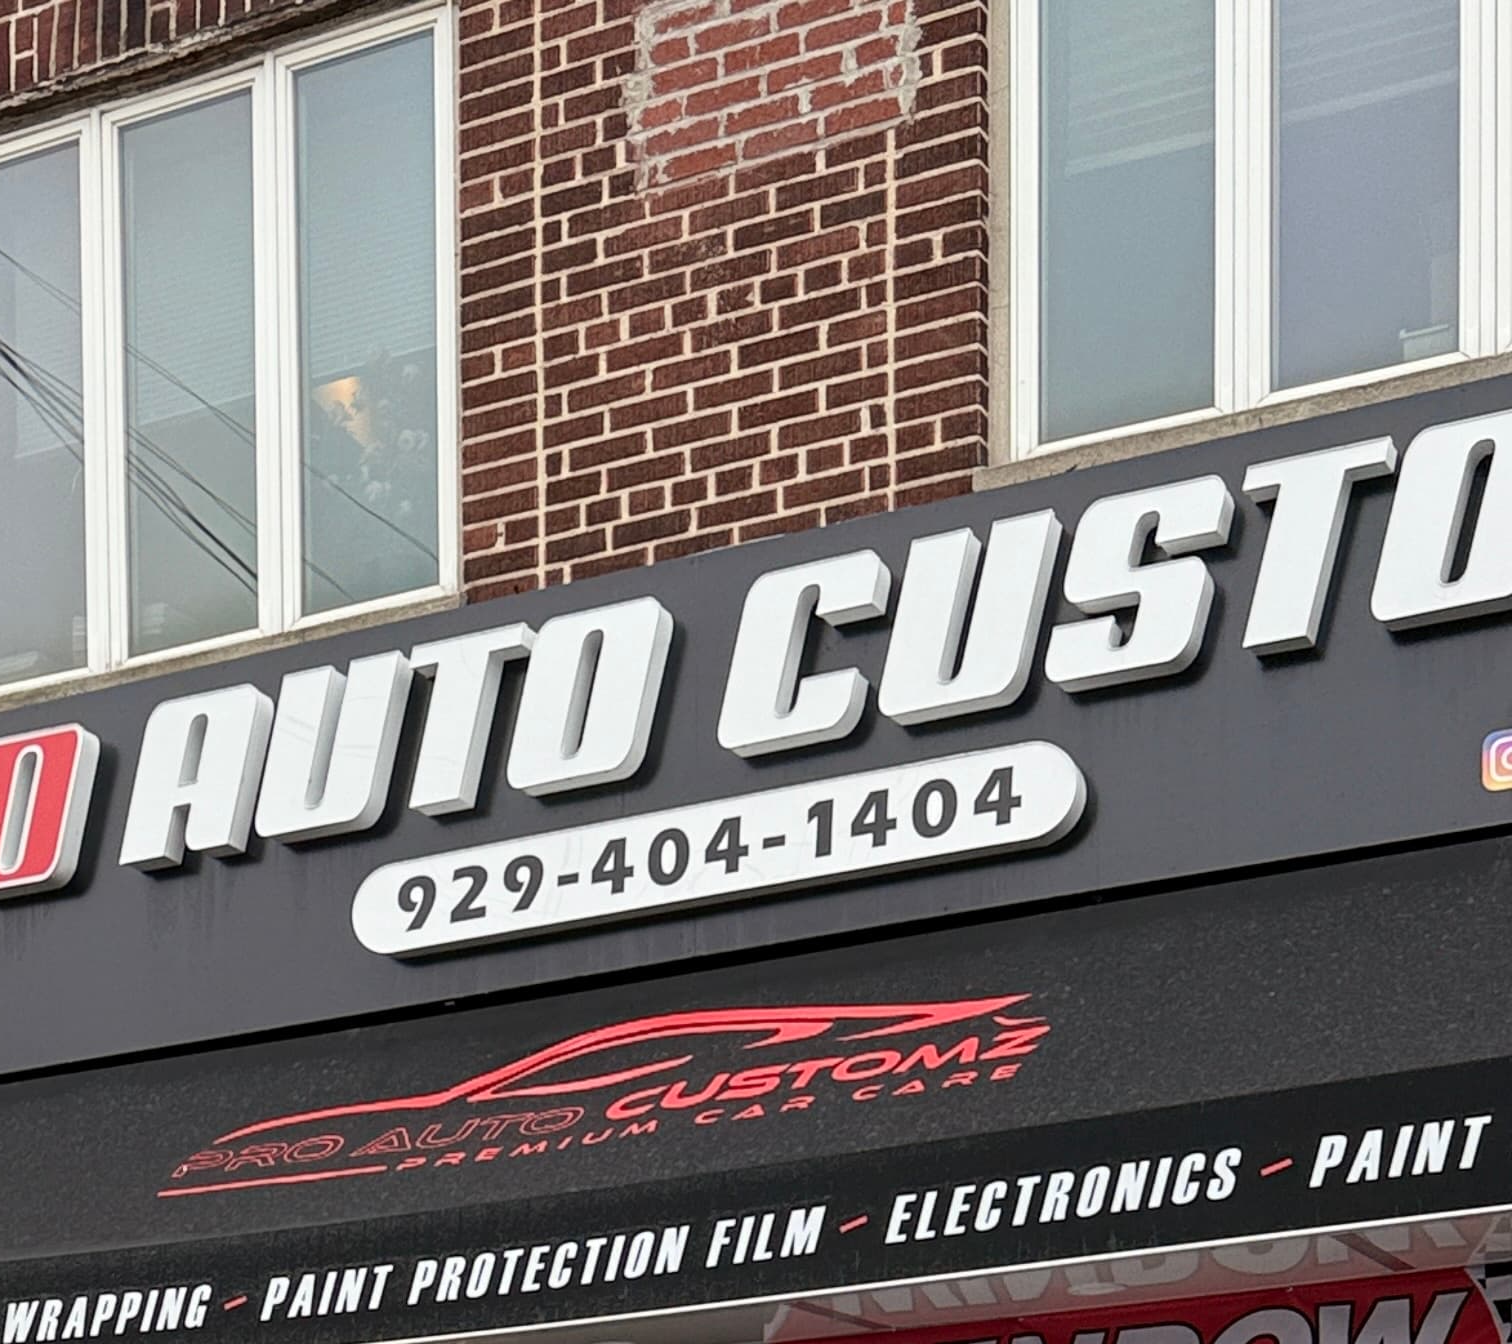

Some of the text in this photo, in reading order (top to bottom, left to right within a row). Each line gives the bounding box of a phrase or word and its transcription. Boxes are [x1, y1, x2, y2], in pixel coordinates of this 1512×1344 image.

[120, 596, 675, 873] AUTO
[397, 766, 1022, 931] 929-404-1404
[171, 1018, 1051, 1178] PRO AUTO CUSTOMZ
[395, 1063, 1023, 1171] PREMIUM CAR CARE
[259, 1264, 394, 1322] PAINT
[407, 1225, 691, 1305] PROTECTION
[705, 1205, 828, 1270] FILM
[884, 1146, 1243, 1244] ELECTRONICS
[1307, 1115, 1492, 1188] PAINT
